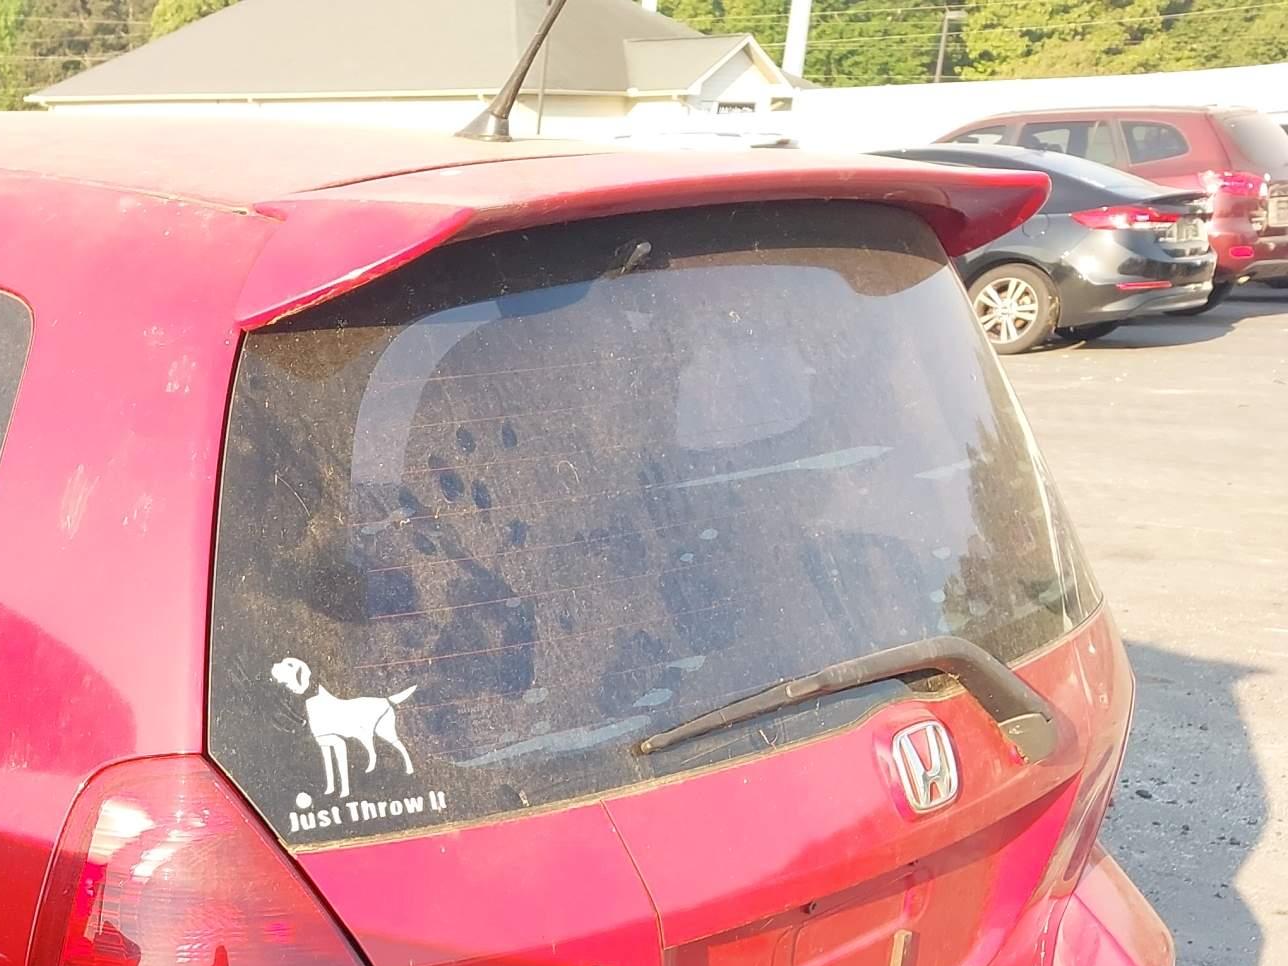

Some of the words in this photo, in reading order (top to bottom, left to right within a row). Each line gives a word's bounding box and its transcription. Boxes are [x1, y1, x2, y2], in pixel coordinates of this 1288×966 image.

[288, 809, 343, 833] Just
[346, 796, 424, 822] Throw
[429, 789, 447, 811] It
